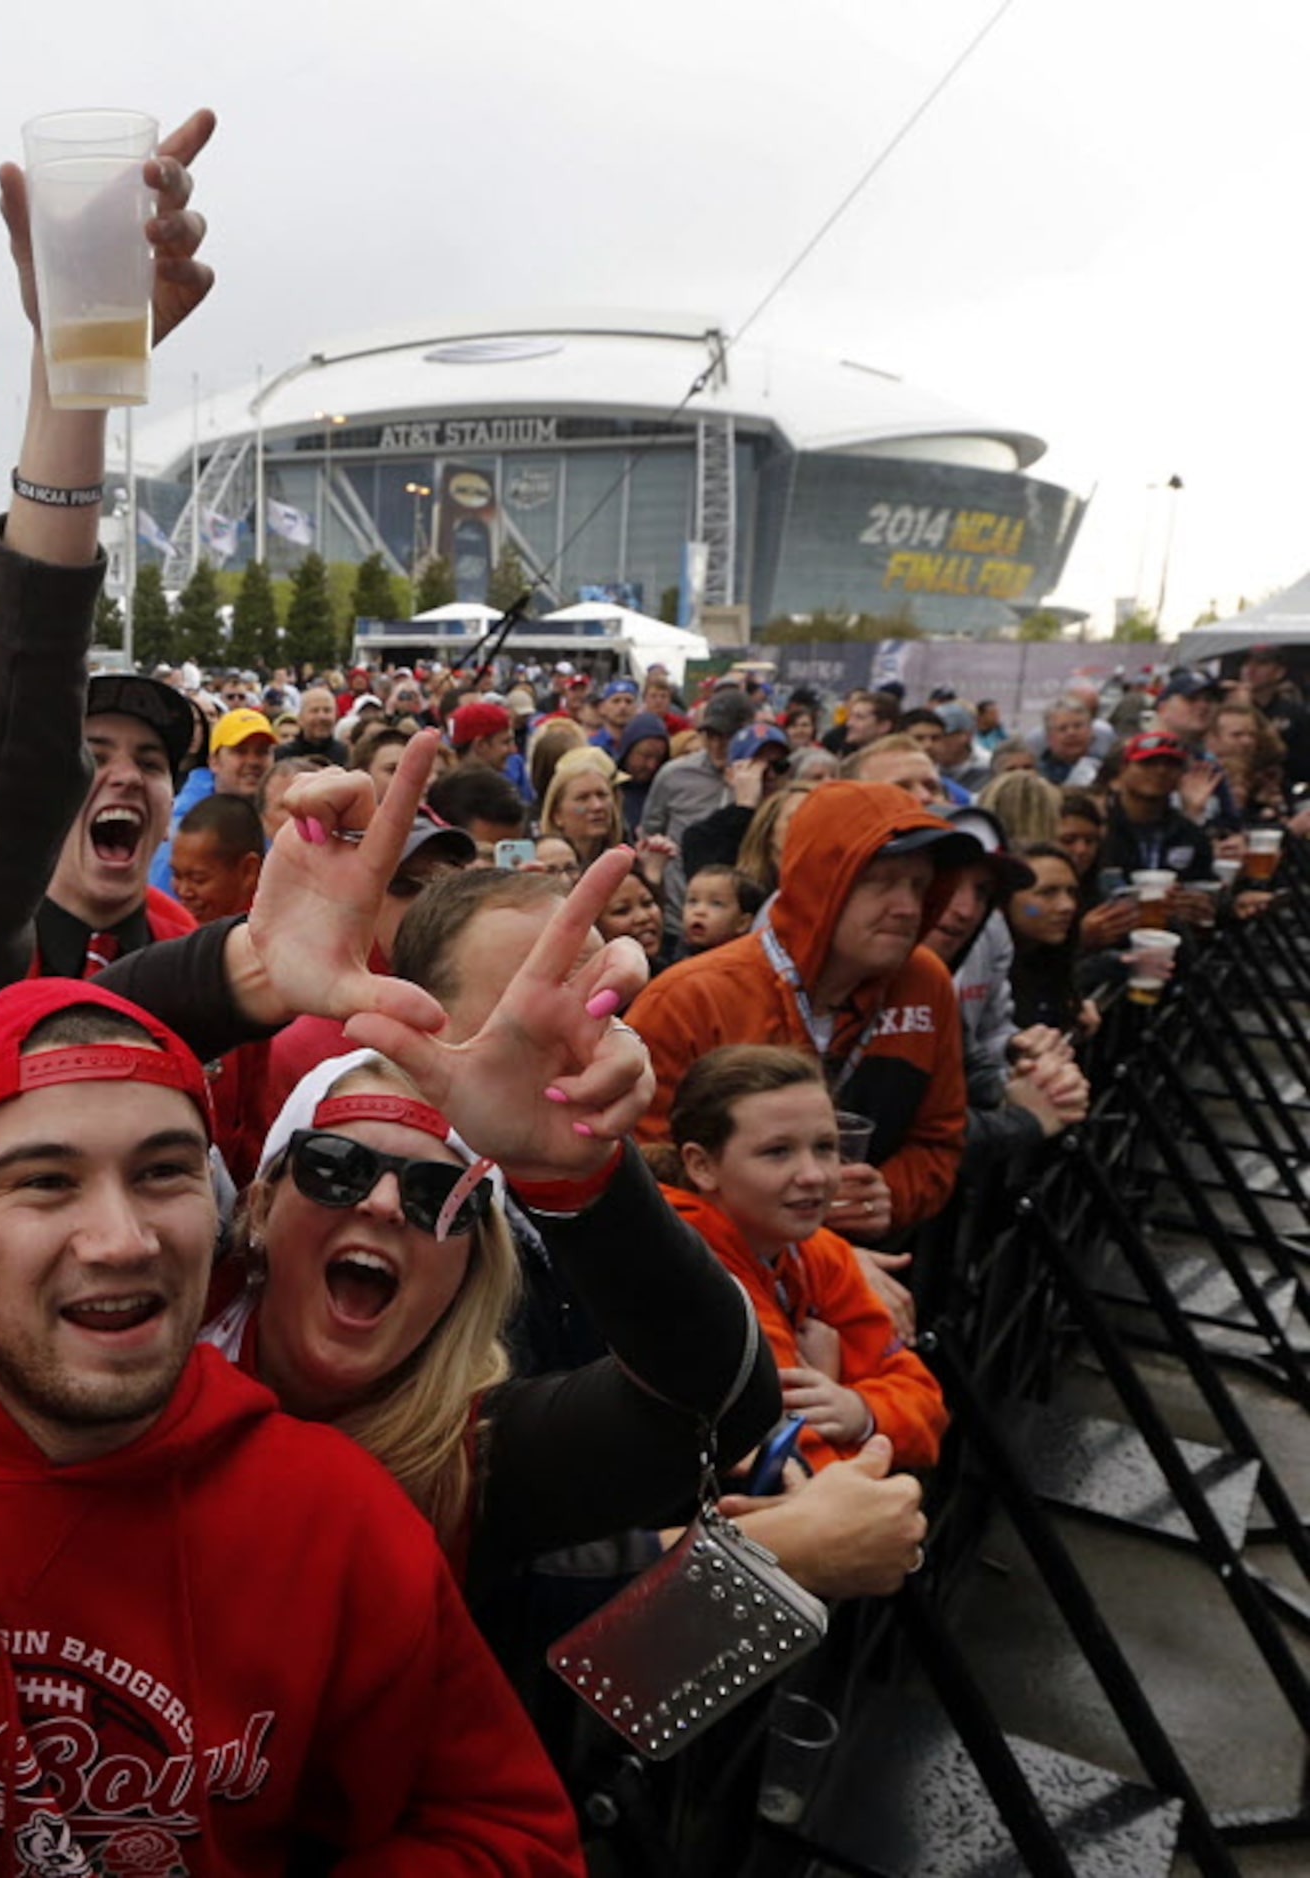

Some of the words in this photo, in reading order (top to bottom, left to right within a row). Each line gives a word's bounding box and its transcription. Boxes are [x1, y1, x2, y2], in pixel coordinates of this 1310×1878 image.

[380, 423, 440, 449] AT&T
[444, 417, 558, 446] STADIUM
[35, 487, 68, 505] NCAA
[859, 502, 950, 547] 2014
[946, 509, 1026, 557] NCAA
[882, 550, 973, 595] FINAL
[60, 1636, 194, 1745] BADGERS
[25, 1711, 275, 1819] Bowl
